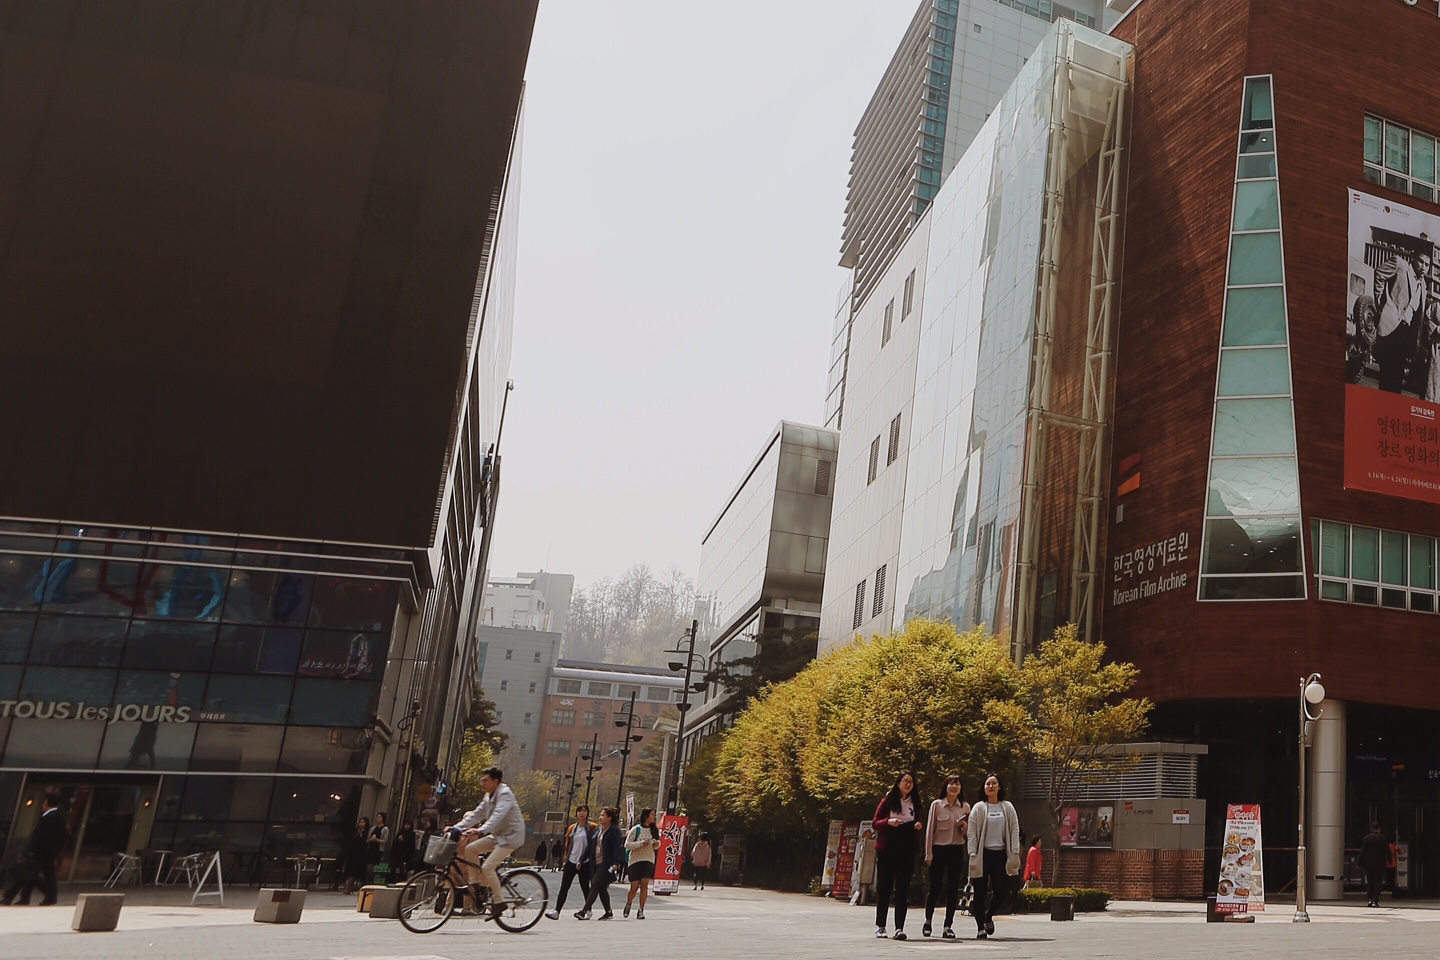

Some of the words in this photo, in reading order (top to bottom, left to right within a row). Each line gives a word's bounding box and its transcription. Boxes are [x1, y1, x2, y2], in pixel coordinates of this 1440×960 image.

[1377, 417, 1413, 440] 영원한
[1415, 425, 1440, 445] 영화
[1377, 439, 1402, 458] 장르
[1404, 445, 1440, 468] 영화의
[1113, 532, 1189, 582] 한국영상자료원
[1113, 588, 1138, 606] Korean
[1139, 580, 1156, 599] Film
[1157, 571, 1187, 594] Archive
[0, 699, 70, 721] TOUS
[76, 702, 110, 722] les
[108, 703, 191, 725] JOURS
